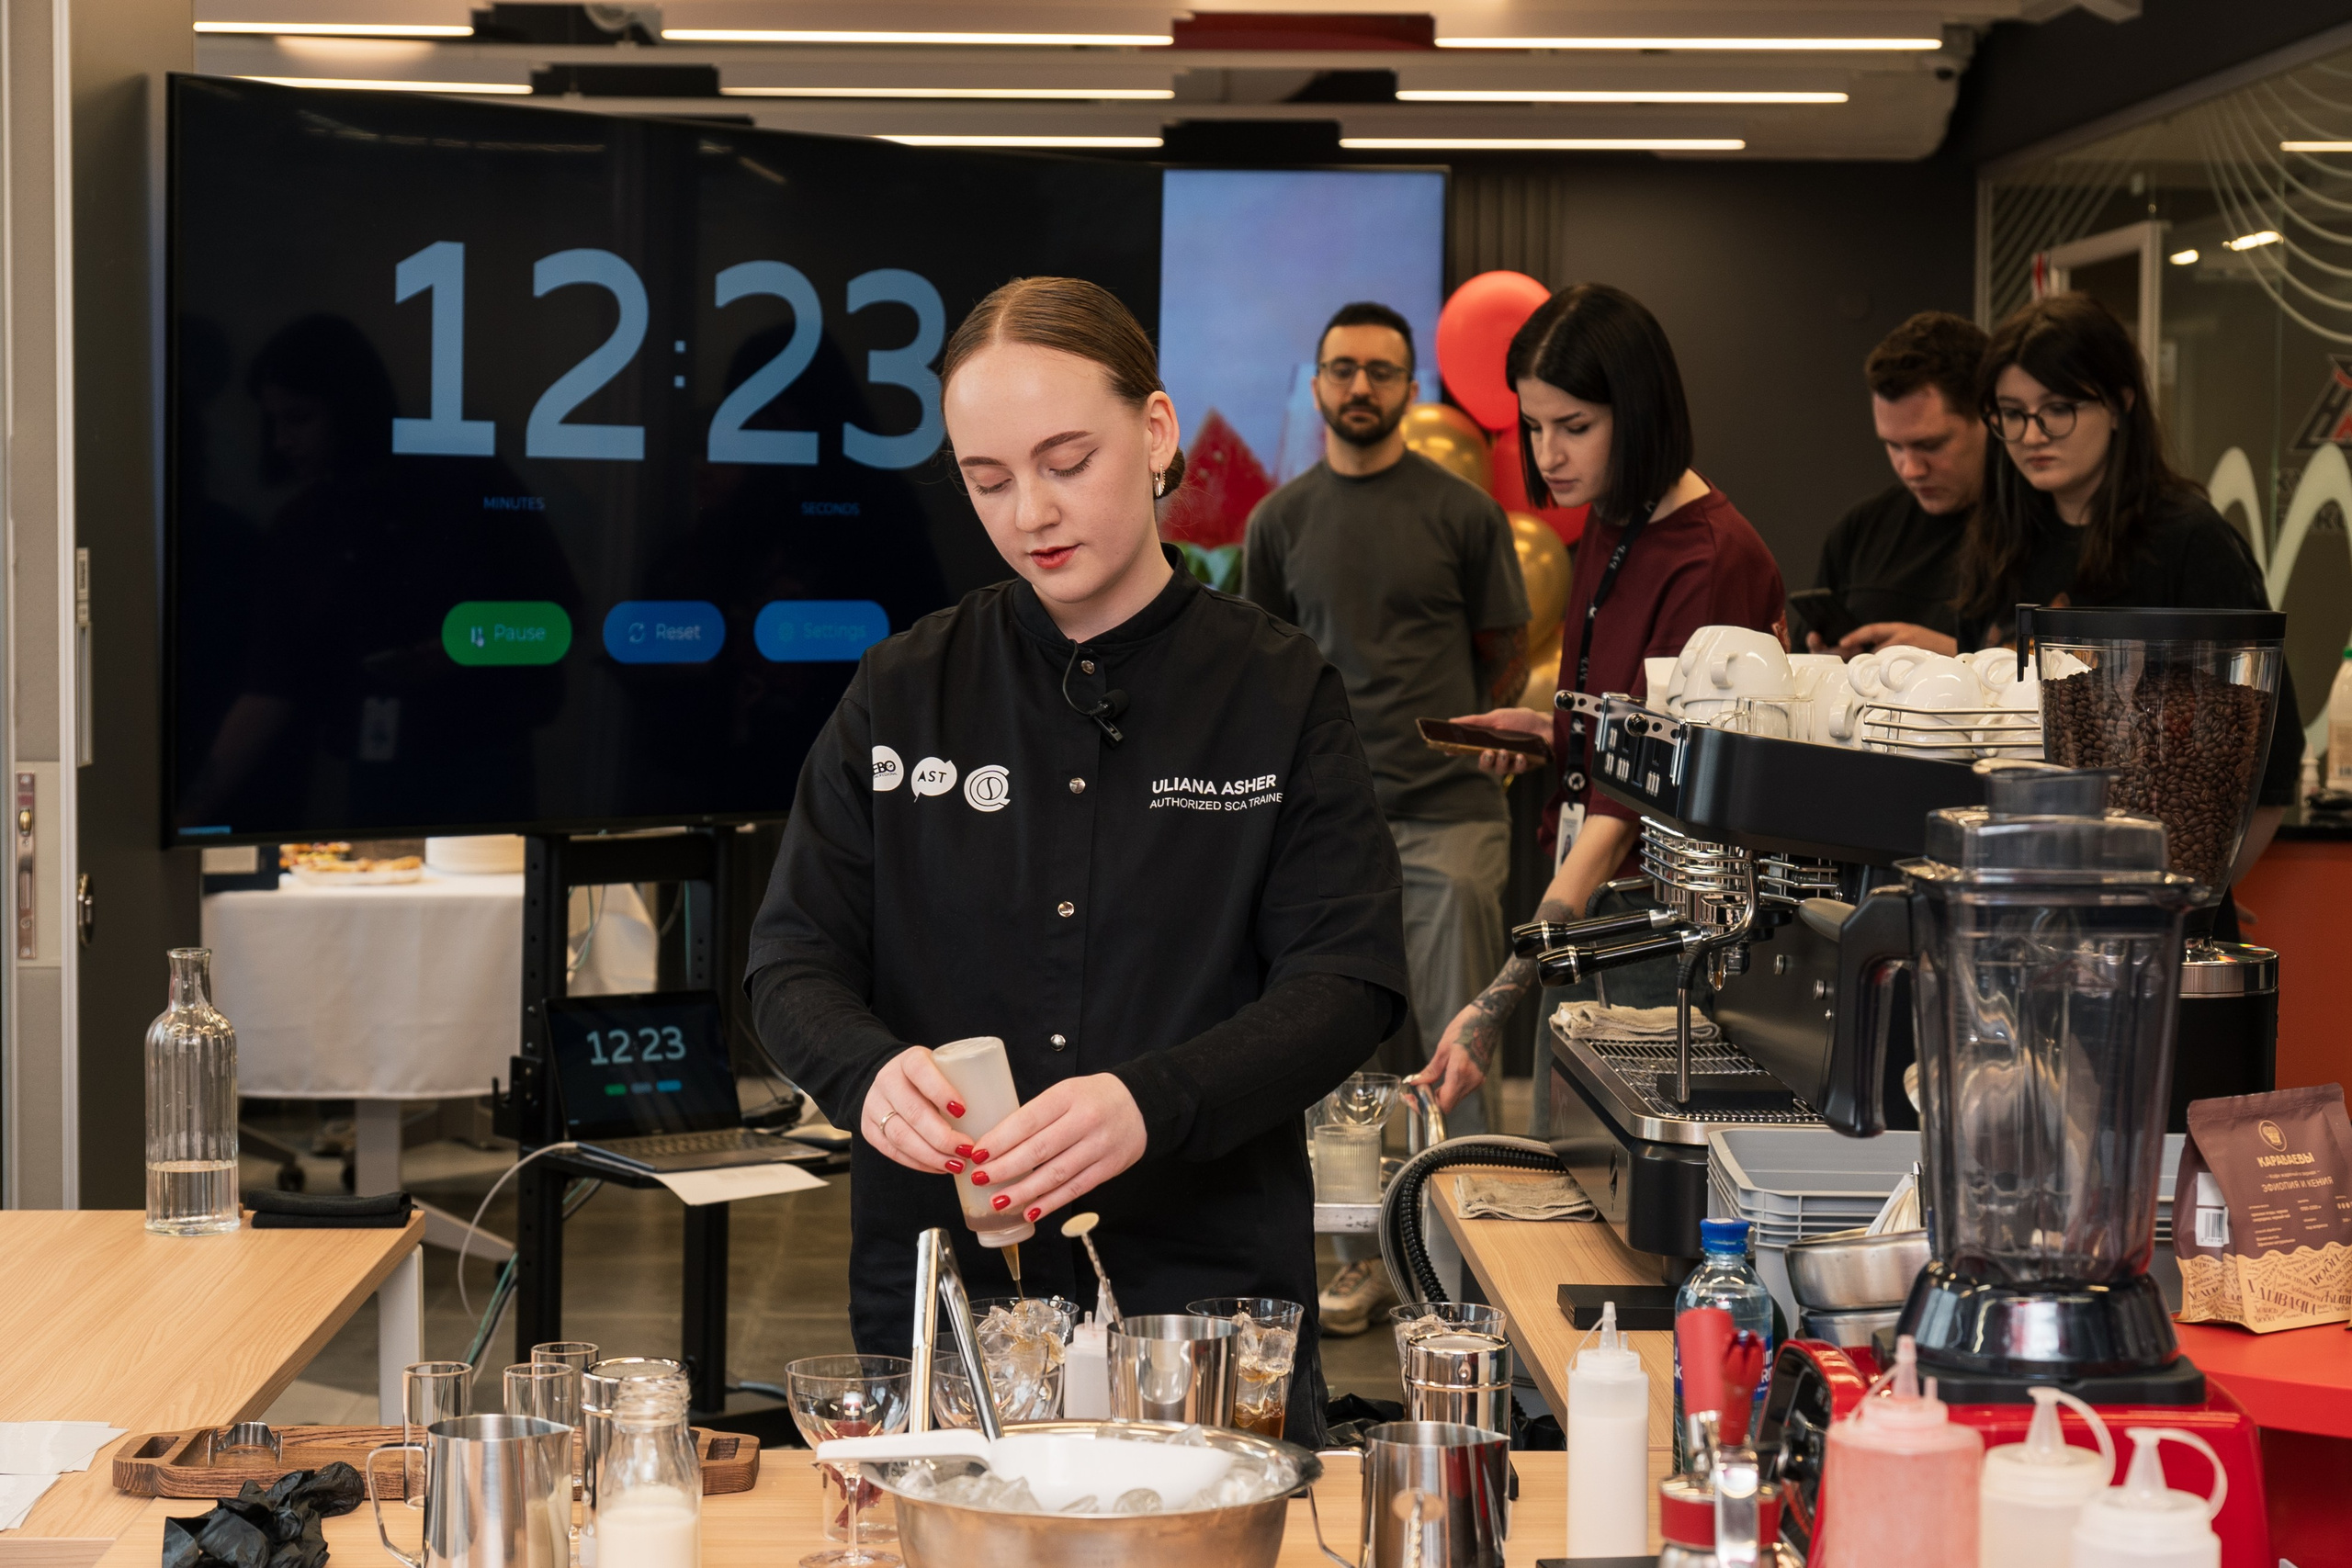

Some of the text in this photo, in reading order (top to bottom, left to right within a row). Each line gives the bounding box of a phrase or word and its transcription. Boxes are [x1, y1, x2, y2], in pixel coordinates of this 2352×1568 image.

[483, 496, 545, 512] MINUTES
[801, 502, 861, 516] SECONDS
[494, 624, 546, 642] Pause
[656, 623, 702, 640] Reset
[803, 622, 866, 641] Settings
[873, 760, 897, 774] EBO
[917, 770, 947, 784] AST
[1152, 773, 1277, 795] ULIANA ASHER
[1149, 793, 1283, 811] AUTHORIZED SCA TRAINE
[2256, 1152, 2315, 1168] КАРАВАЕВЫ
[2261, 1176, 2335, 1193] ЭФИОПИЯ И КЕНИЯ
